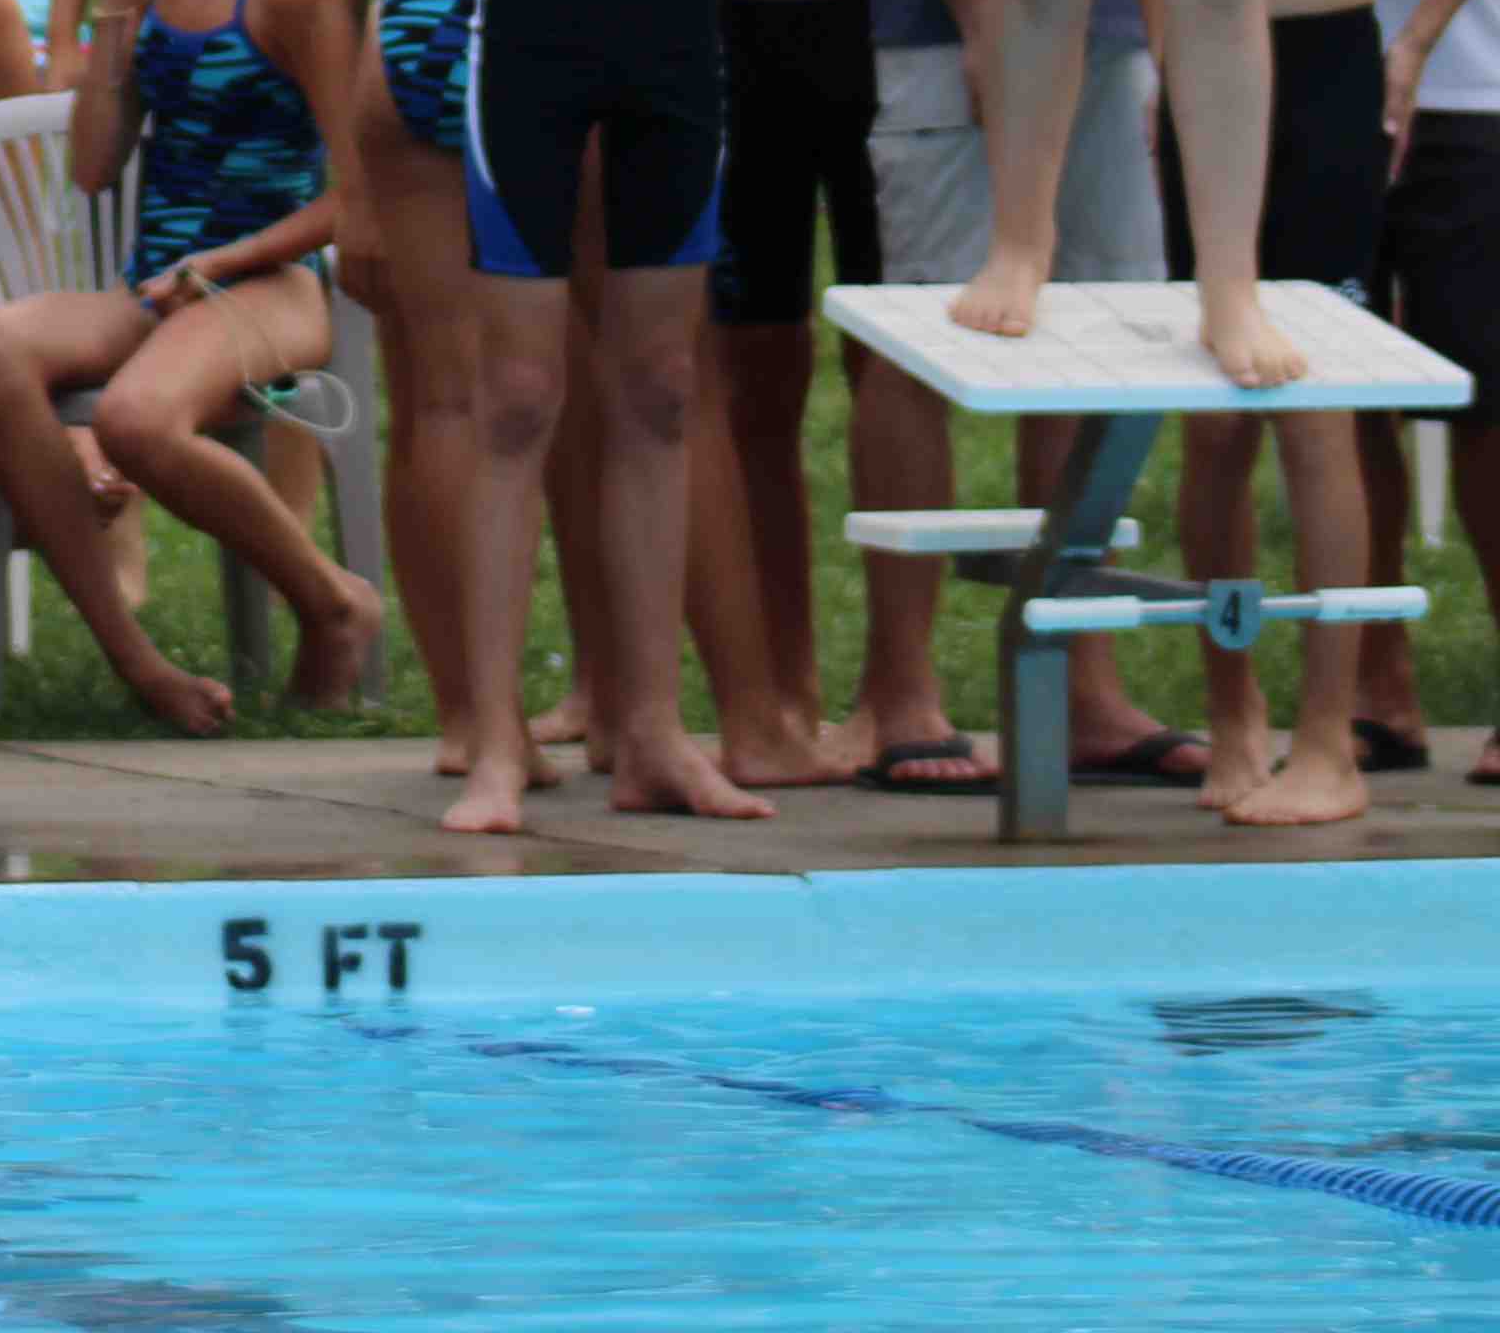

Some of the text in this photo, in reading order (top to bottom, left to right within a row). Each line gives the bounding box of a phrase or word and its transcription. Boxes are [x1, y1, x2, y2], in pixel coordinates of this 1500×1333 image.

[1220, 588, 1241, 636] 4
[222, 918, 422, 992] 5 FT
